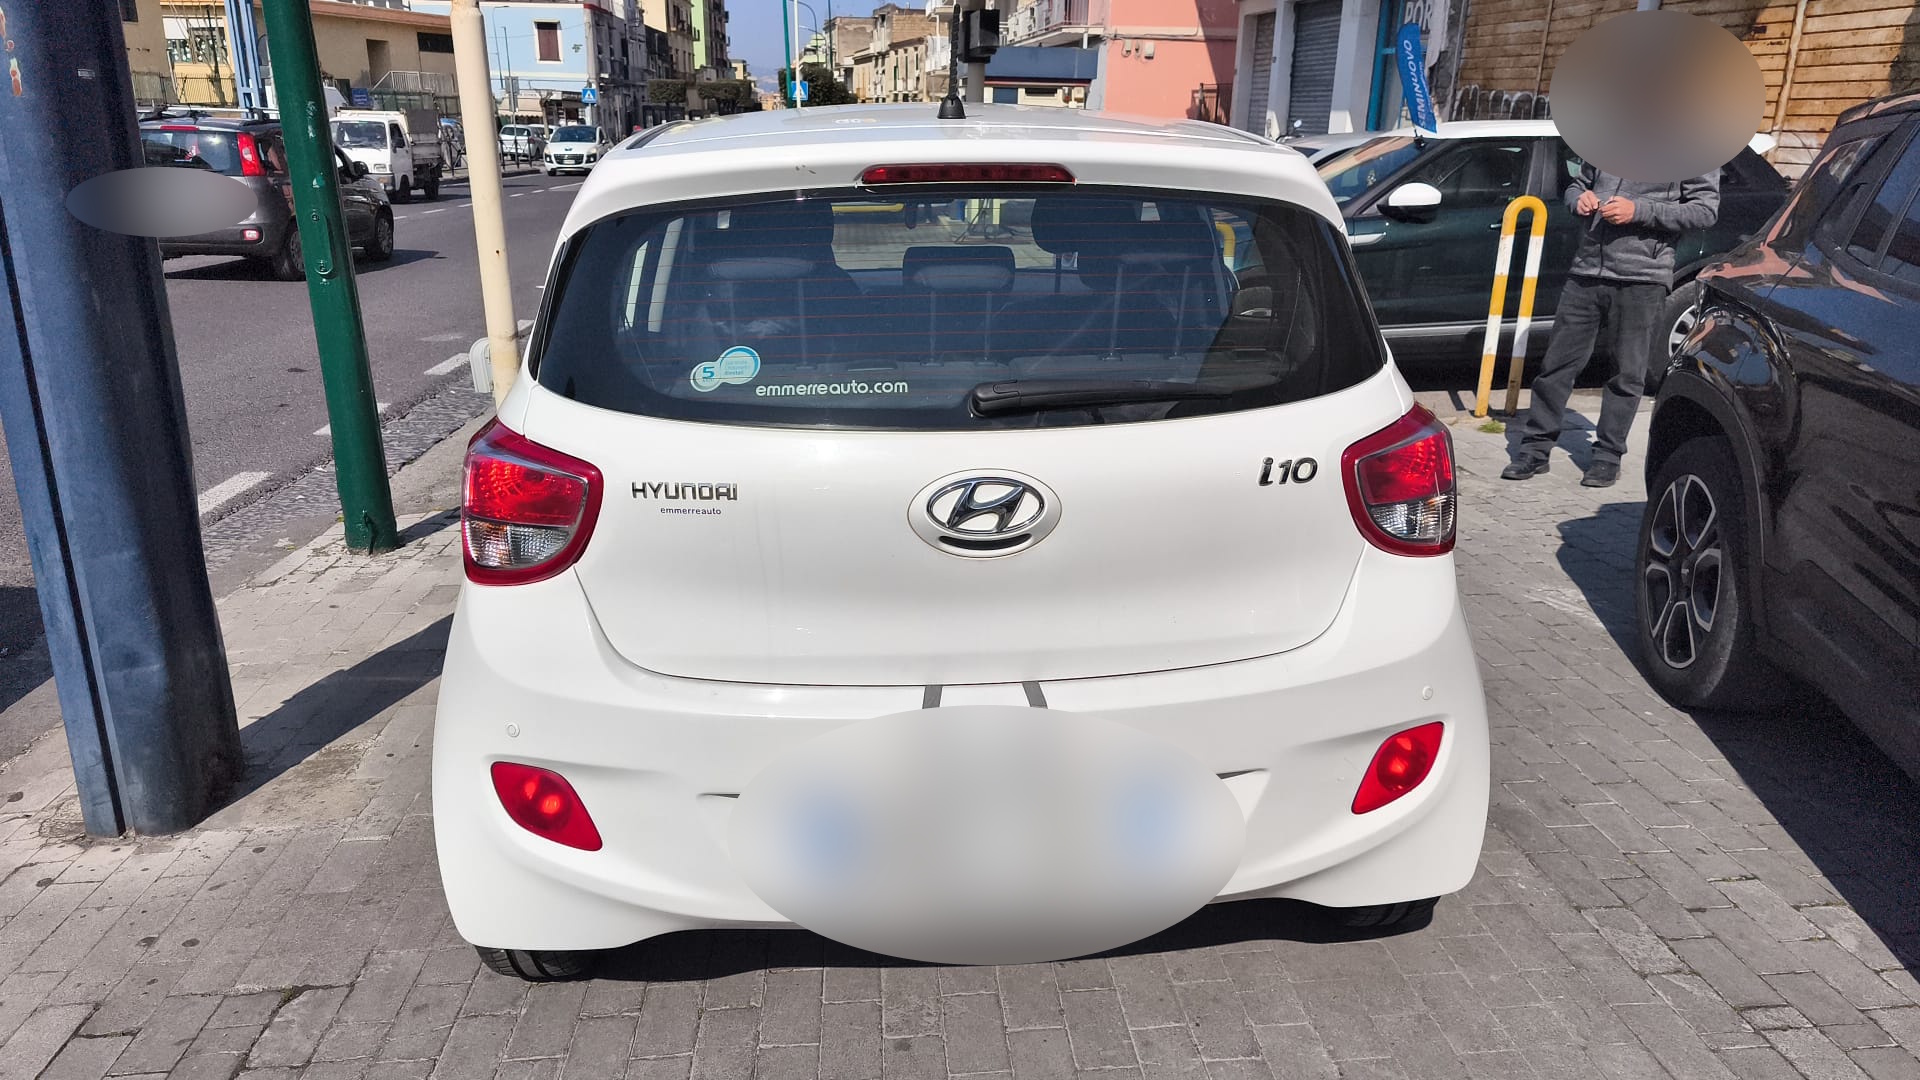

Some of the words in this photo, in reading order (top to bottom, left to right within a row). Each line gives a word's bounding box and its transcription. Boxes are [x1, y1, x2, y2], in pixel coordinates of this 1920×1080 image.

[1403, 39, 1426, 128] SEMINUOVO
[702, 366, 715, 379] 5
[755, 380, 909, 397] emmerreauto.com
[1258, 456, 1318, 487] i10
[631, 481, 738, 500] HYUNDAI
[660, 507, 722, 516] emmerreauto
